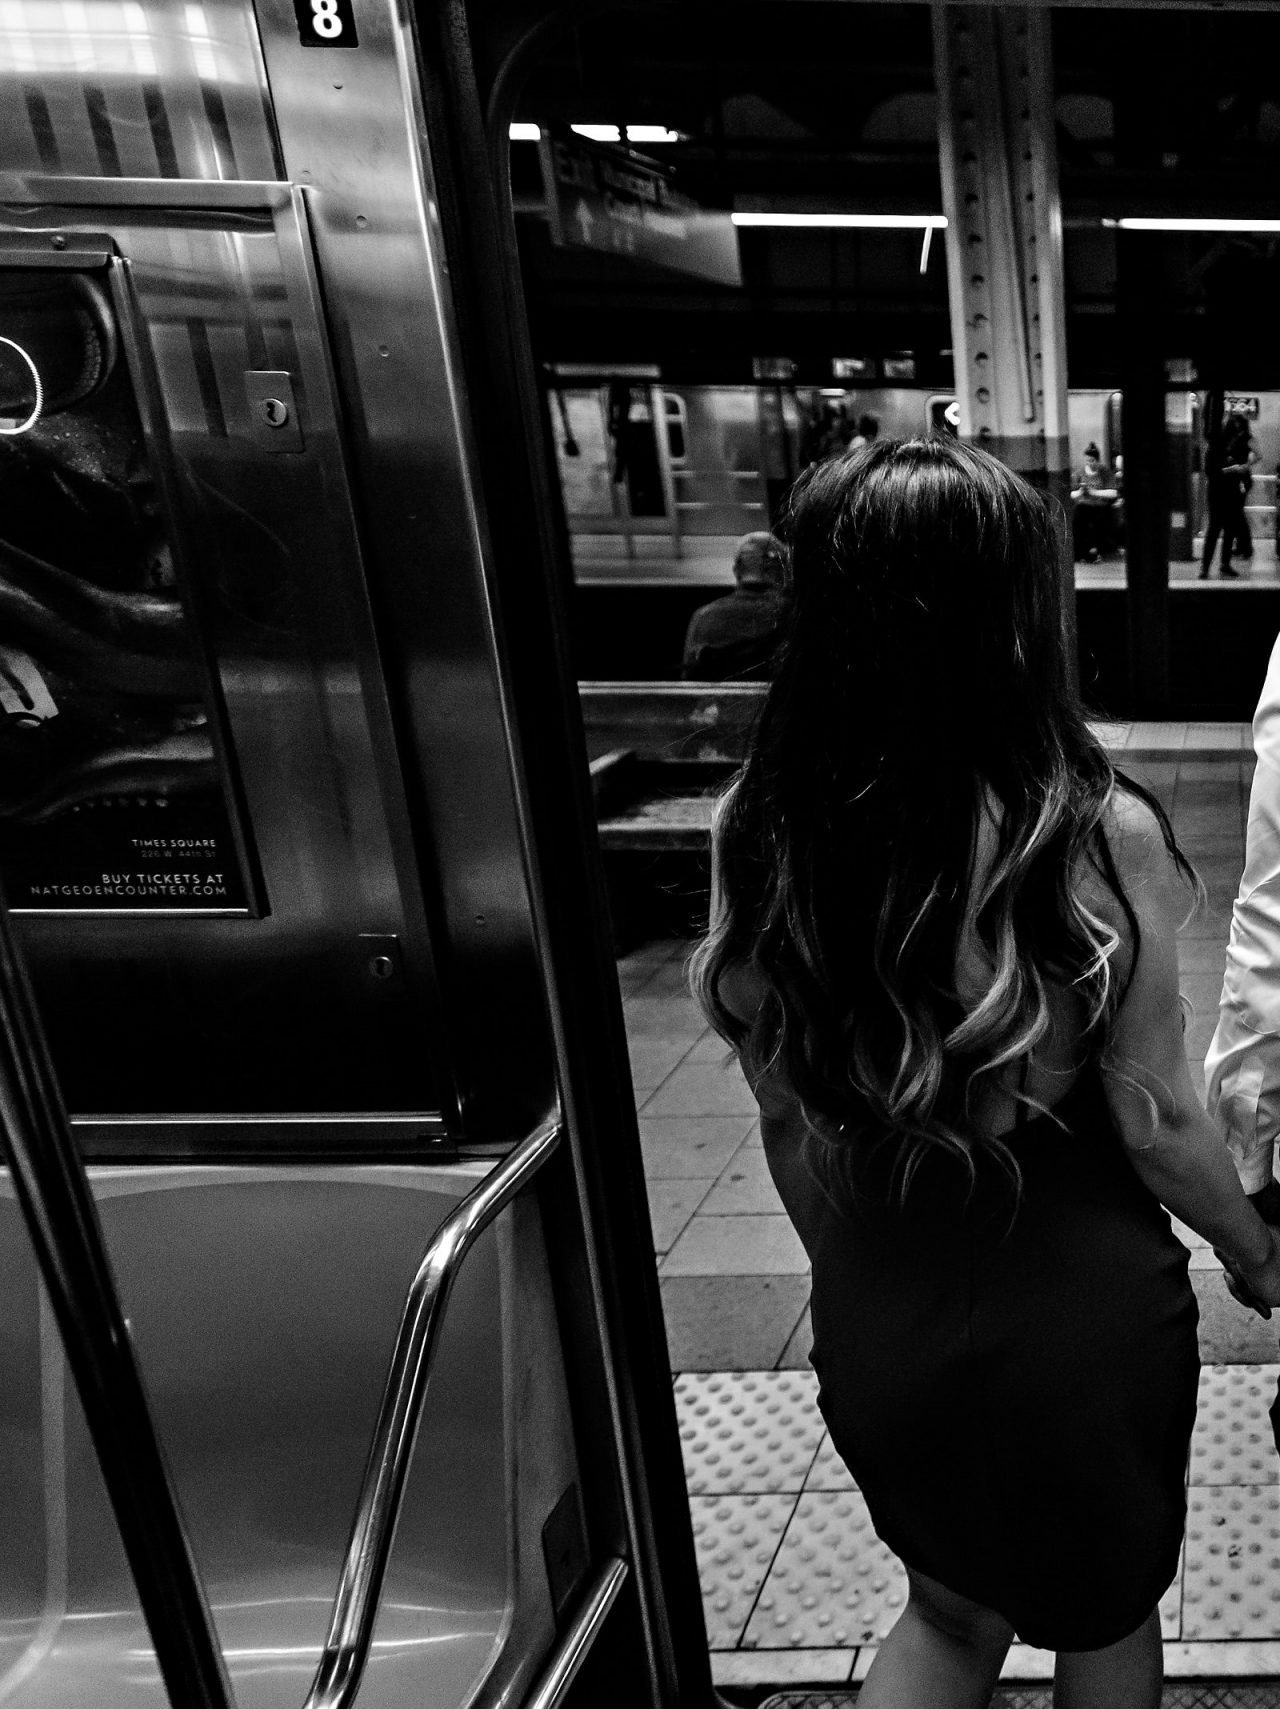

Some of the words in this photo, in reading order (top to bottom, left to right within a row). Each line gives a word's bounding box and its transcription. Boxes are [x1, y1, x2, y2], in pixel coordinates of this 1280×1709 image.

[311, 0, 343, 39] 8
[131, 839, 167, 848] TIMES
[170, 839, 216, 848] SQUARE
[102, 874, 131, 884] BUY
[137, 874, 201, 884] TICKETS
[206, 874, 224, 884] AT
[30, 885, 228, 896] NATGEOENCOUNTER.COM
